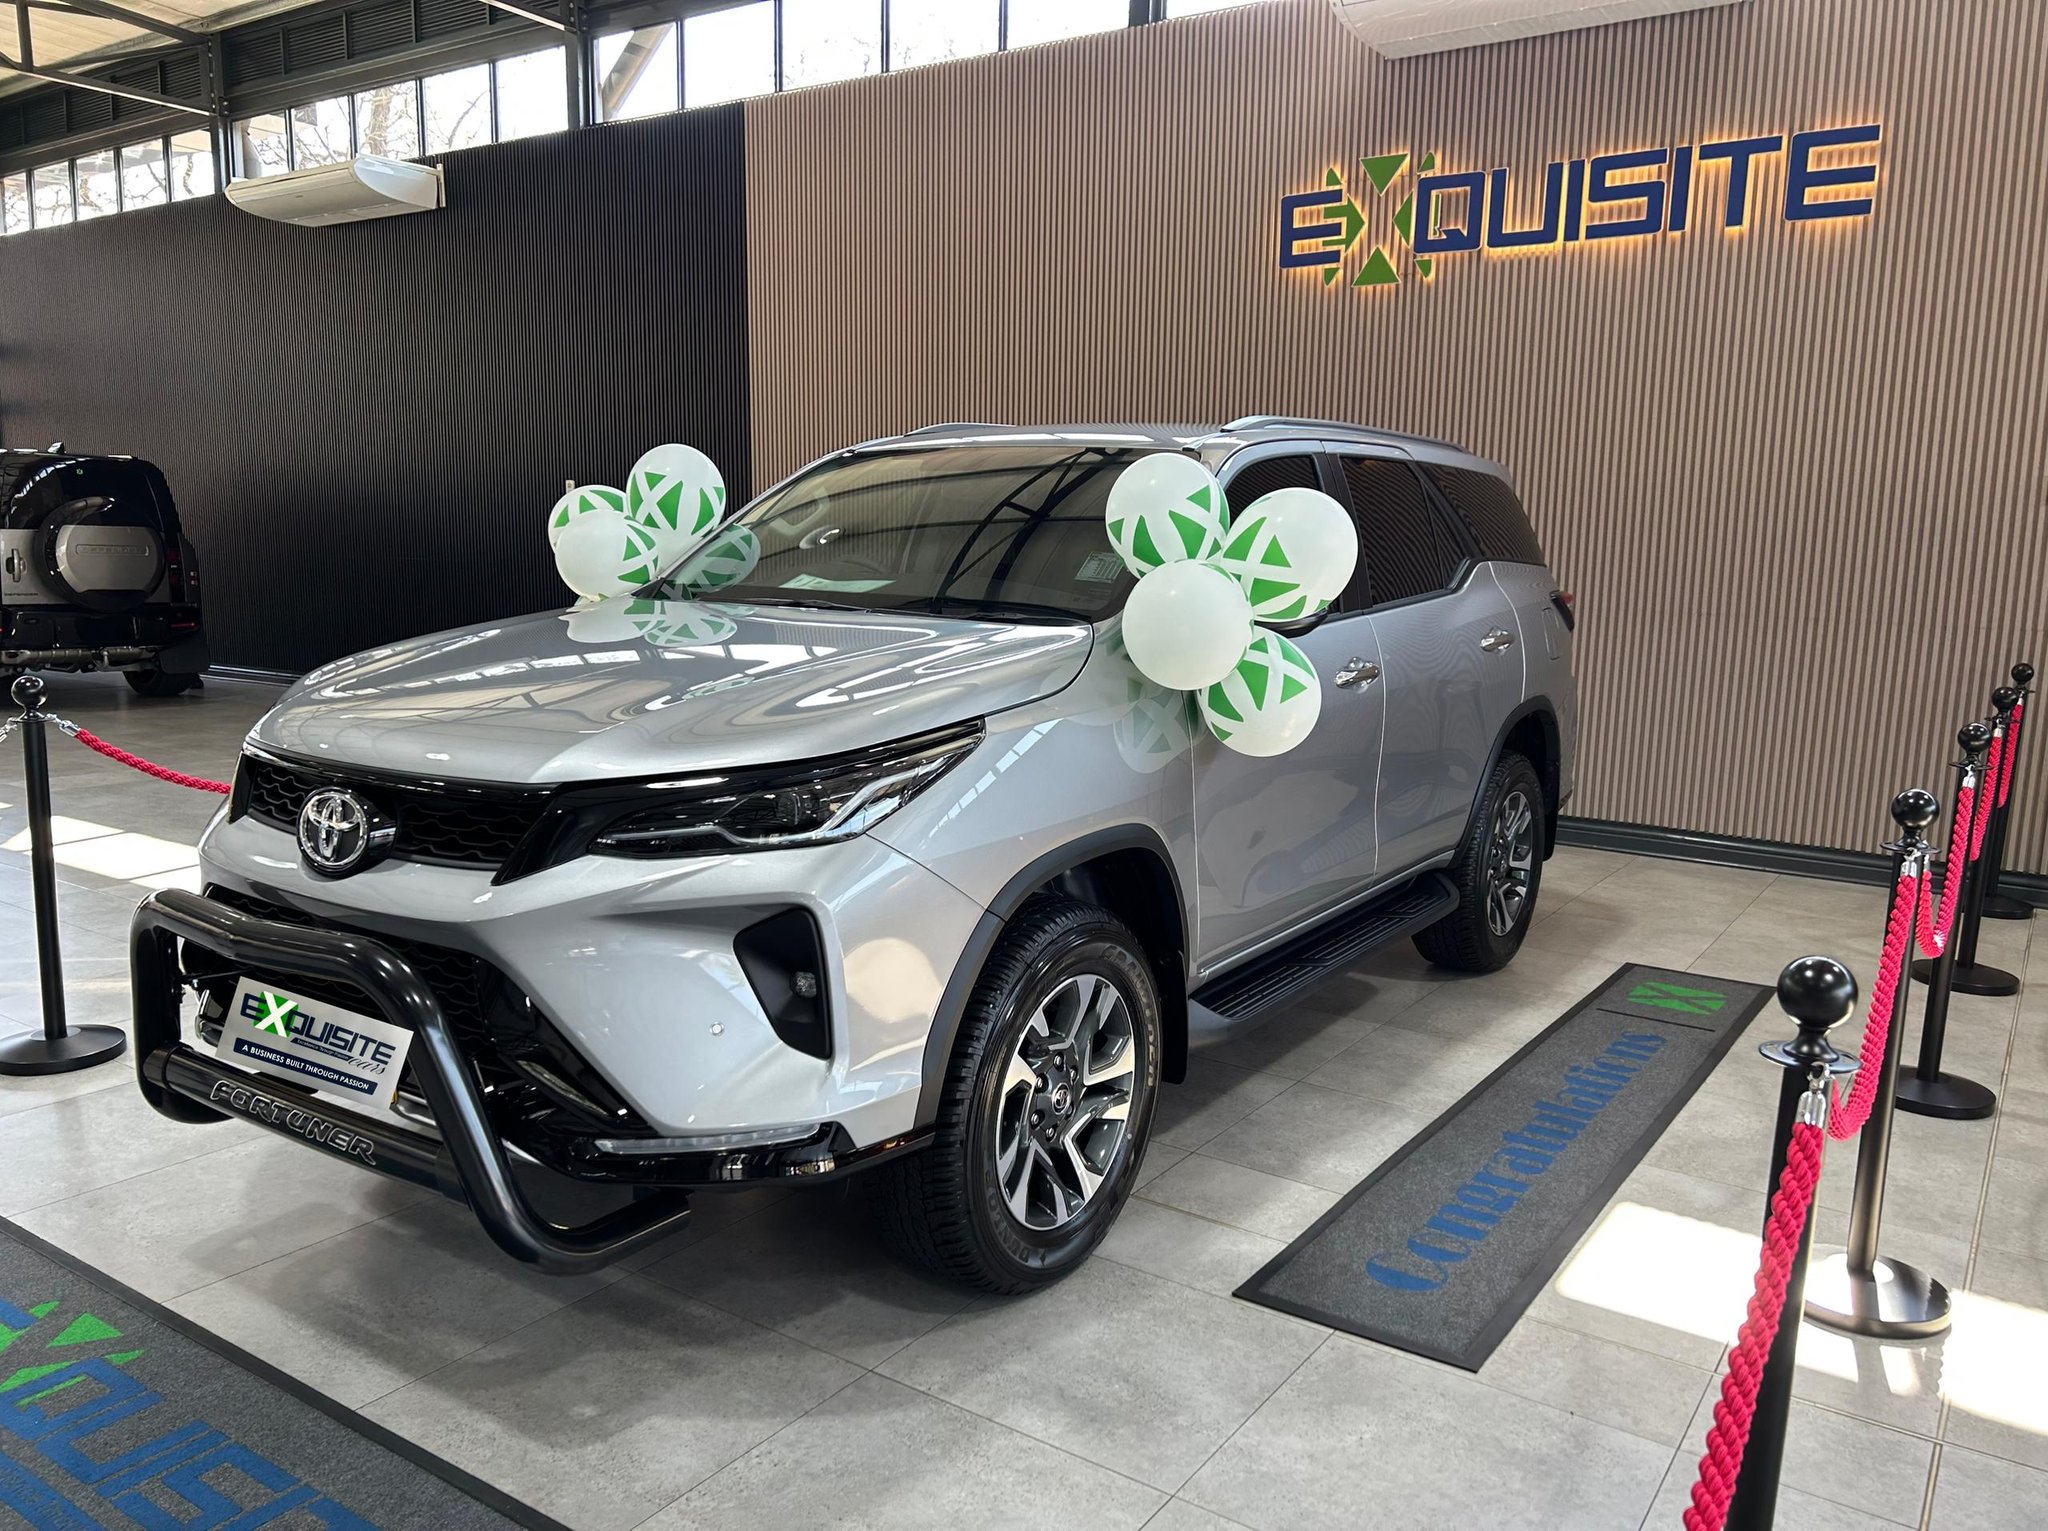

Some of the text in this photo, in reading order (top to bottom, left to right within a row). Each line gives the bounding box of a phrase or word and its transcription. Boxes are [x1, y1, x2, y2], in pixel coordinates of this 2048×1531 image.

[1280, 123, 1882, 288] EXQUISITE
[240, 990, 397, 1066] EXQUISITE
[242, 1044, 370, 1091] A BUSINESS BUILT THROUGH PASSION
[210, 1080, 377, 1166] FORTUNER
[1366, 1031, 1669, 1293] Congratulations
